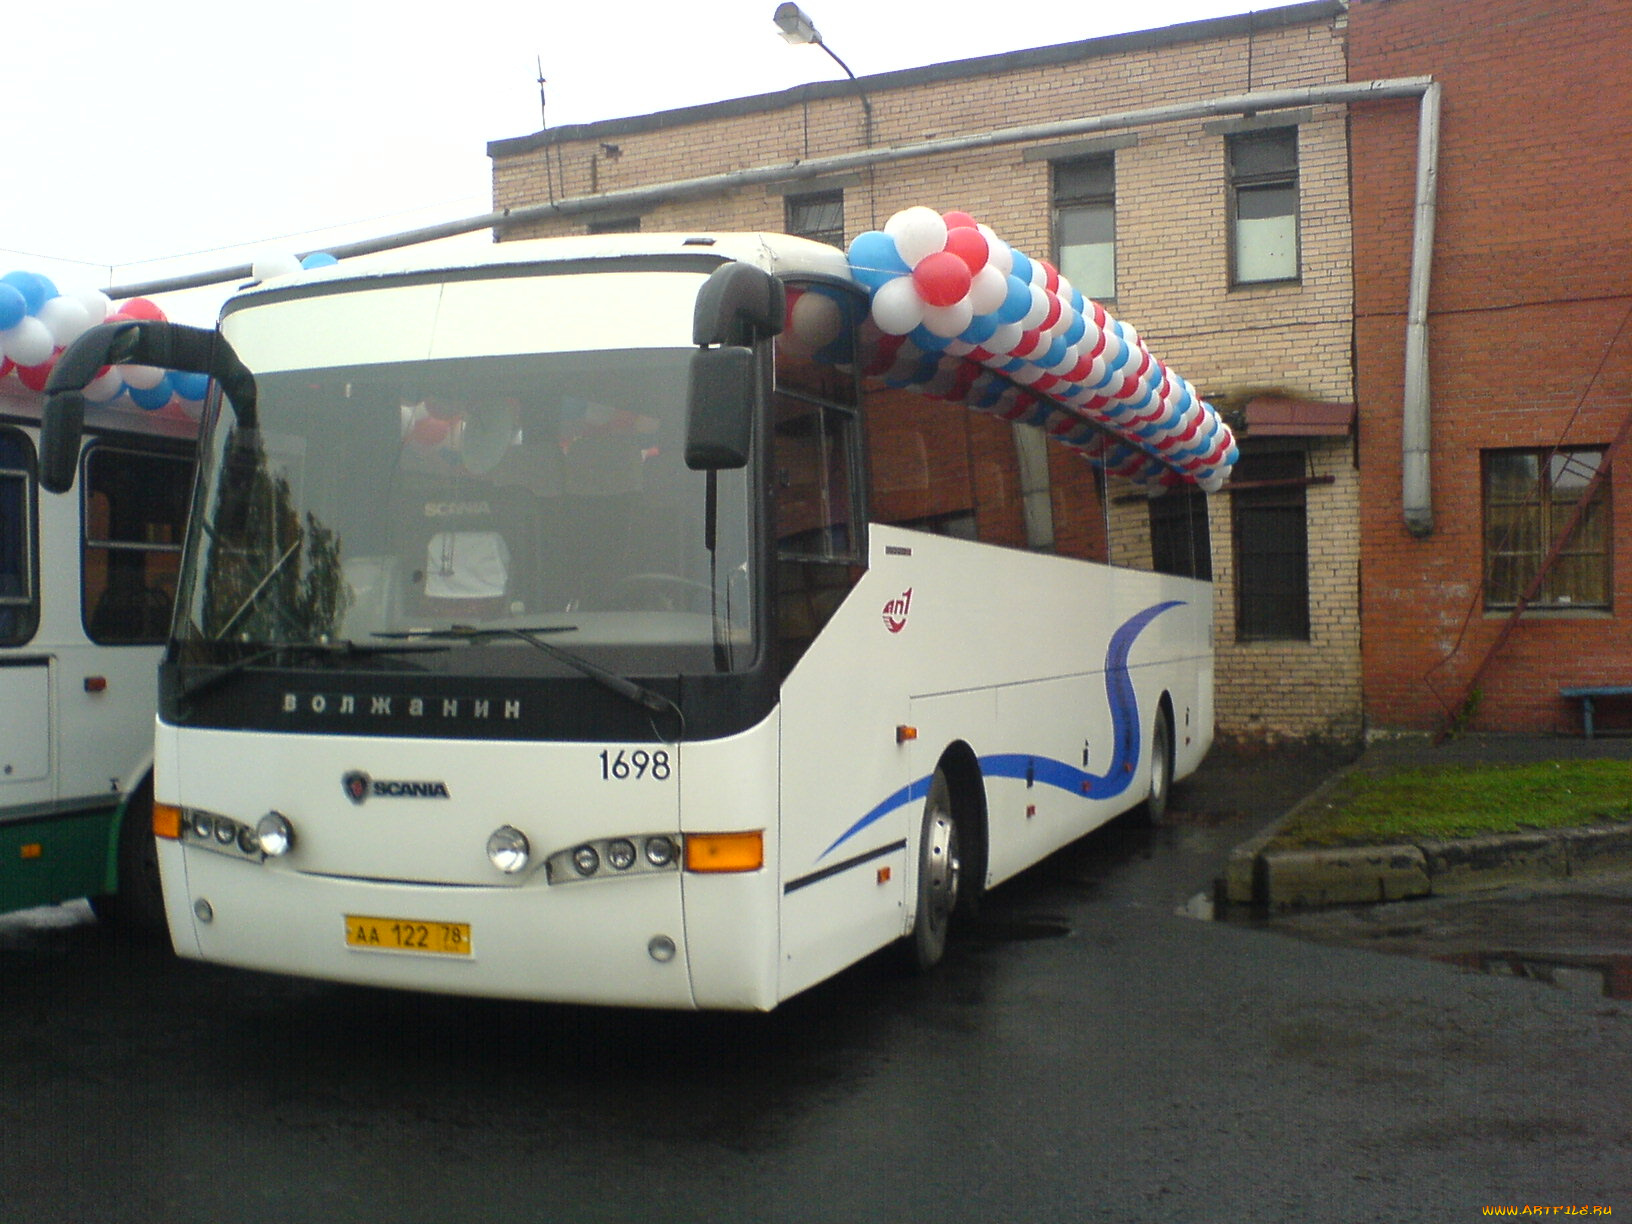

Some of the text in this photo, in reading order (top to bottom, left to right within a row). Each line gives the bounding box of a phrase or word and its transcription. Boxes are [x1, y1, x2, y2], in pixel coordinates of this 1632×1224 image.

[599, 749, 671, 780] 1698
[373, 781, 448, 797] SCANIA
[391, 923, 430, 948] 122
[441, 925, 462, 944] 78
